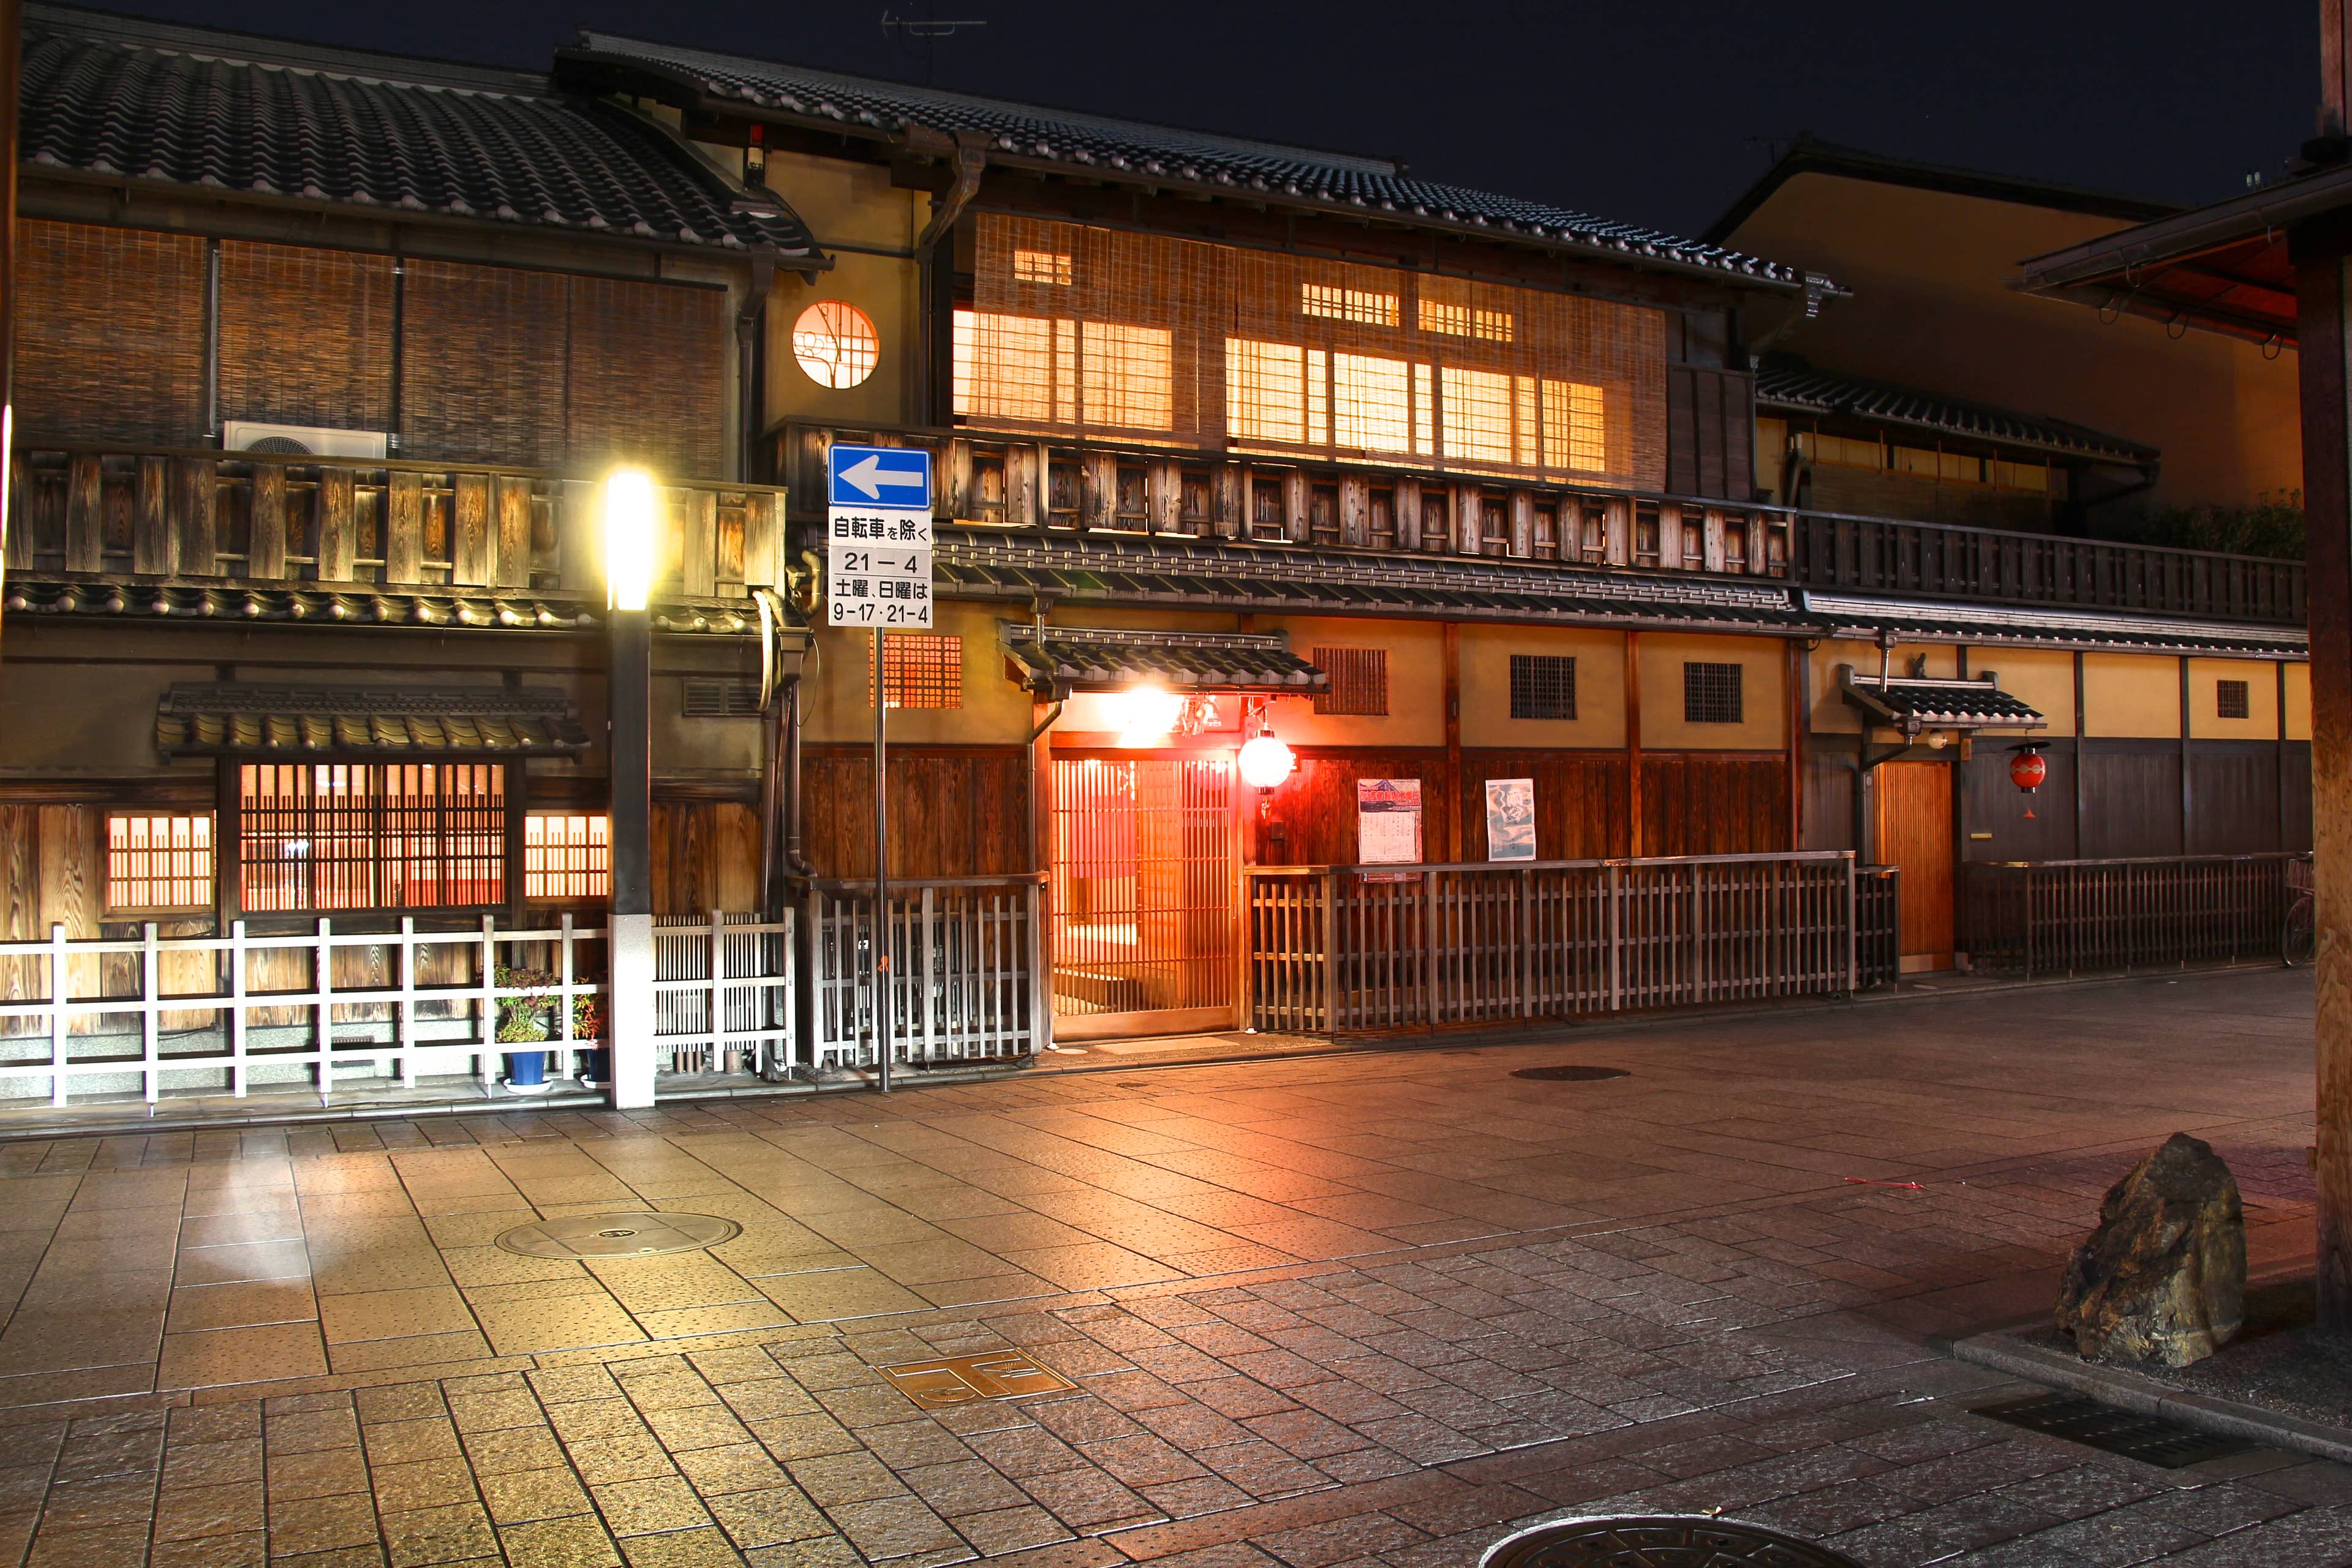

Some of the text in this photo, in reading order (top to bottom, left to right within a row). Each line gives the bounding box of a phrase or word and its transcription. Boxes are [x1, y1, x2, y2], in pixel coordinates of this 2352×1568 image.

[834, 516, 927, 541] 自転車を除く
[835, 578, 927, 600] 土曜、日曜は
